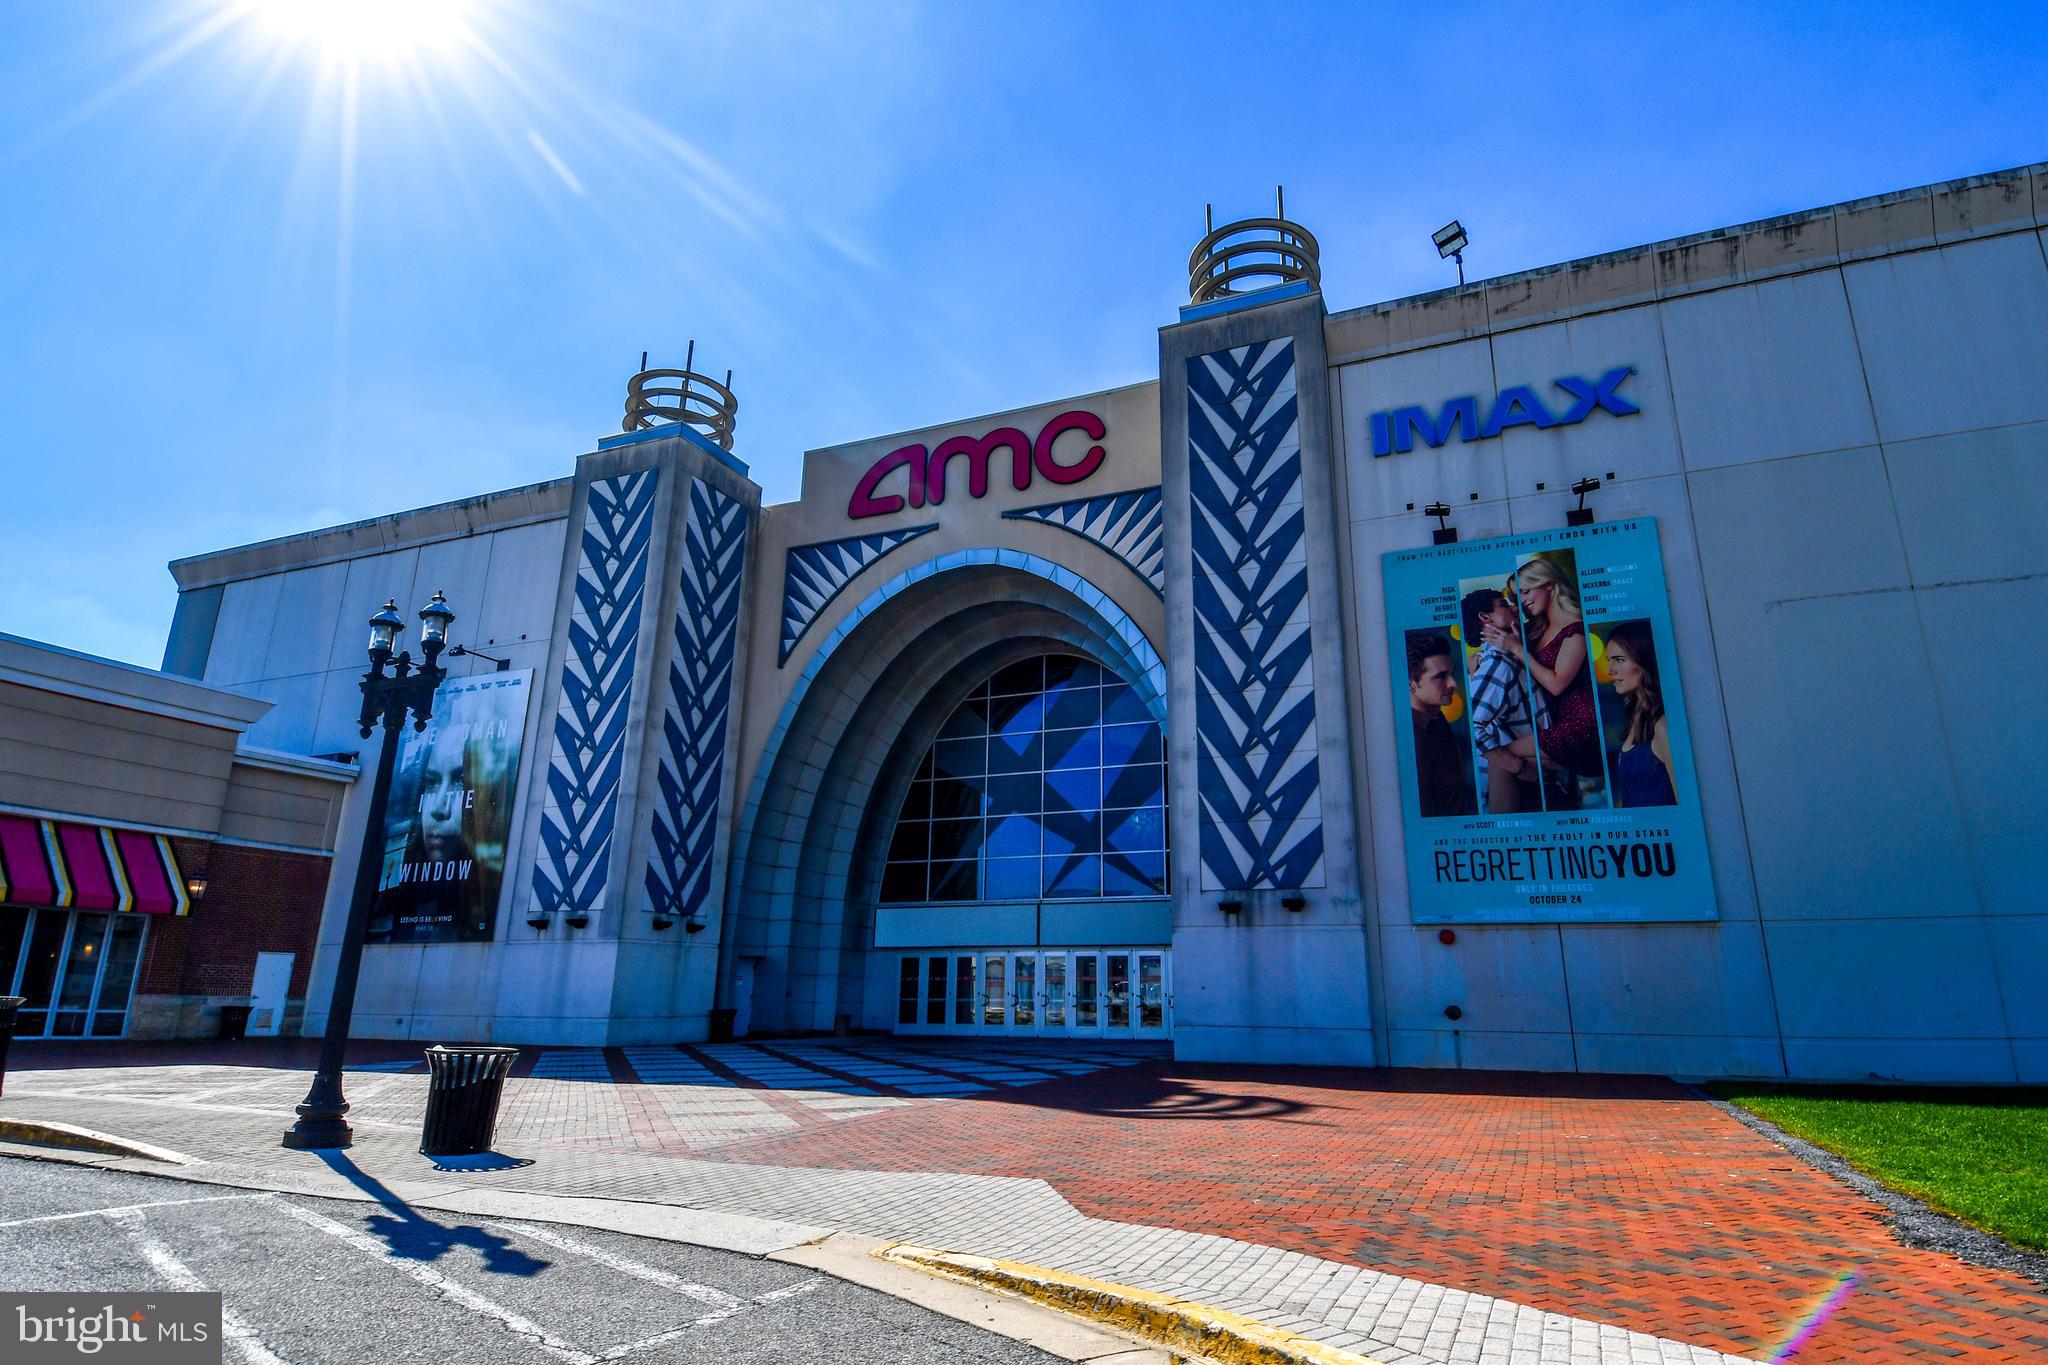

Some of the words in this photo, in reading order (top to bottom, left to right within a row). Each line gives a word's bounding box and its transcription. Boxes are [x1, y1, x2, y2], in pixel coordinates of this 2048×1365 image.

[1371, 366, 1641, 458] IMAX
[1495, 540, 1525, 549] AUTHOR
[1559, 530, 1585, 540] ENDS
[1592, 525, 1618, 536] WITH
[1624, 523, 1637, 531] US
[1580, 567, 1605, 576] ALLISON
[1441, 586, 1456, 594] RISK
[1420, 595, 1457, 606] EVERYTHING
[1584, 594, 1599, 603] DAVE
[1434, 604, 1457, 612] REGRET
[1586, 607, 1607, 616] MASON
[1433, 613, 1457, 622] NOTHING
[446, 789, 475, 811] THE
[1476, 821, 1495, 829] SCOTT
[1569, 816, 1589, 825] WILLA
[1528, 834, 1546, 842] THE
[1553, 832, 1583, 840] FAULT
[1591, 831, 1600, 839] IN
[1608, 831, 1628, 839] OUR
[1635, 828, 1670, 838] STARS
[400, 859, 472, 883] WINDOW
[1515, 883, 1536, 894] ONLY
[1529, 895, 1567, 905] OCTOBER
[1570, 895, 1582, 904] 24
